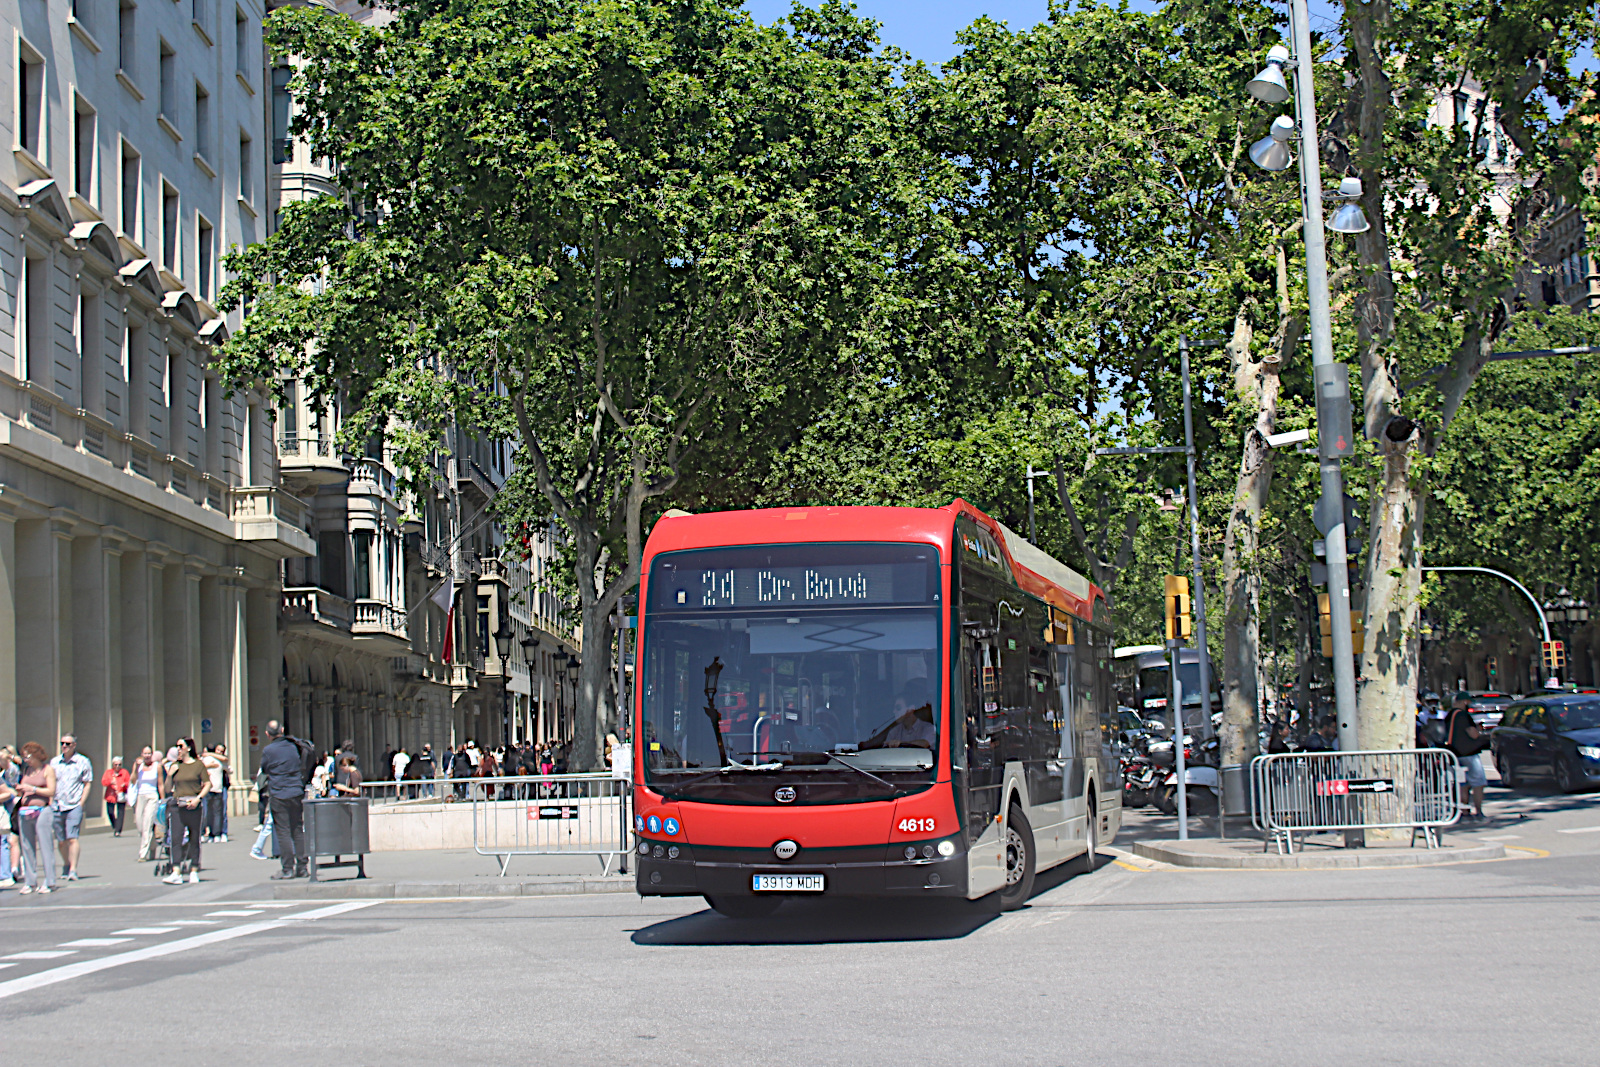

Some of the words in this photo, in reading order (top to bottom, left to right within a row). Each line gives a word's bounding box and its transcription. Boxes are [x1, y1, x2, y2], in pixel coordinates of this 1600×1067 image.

[758, 571, 795, 601] Dr.
[898, 818, 935, 832] 4613
[762, 876, 793, 889] 3919
[797, 876, 821, 889] MDH
